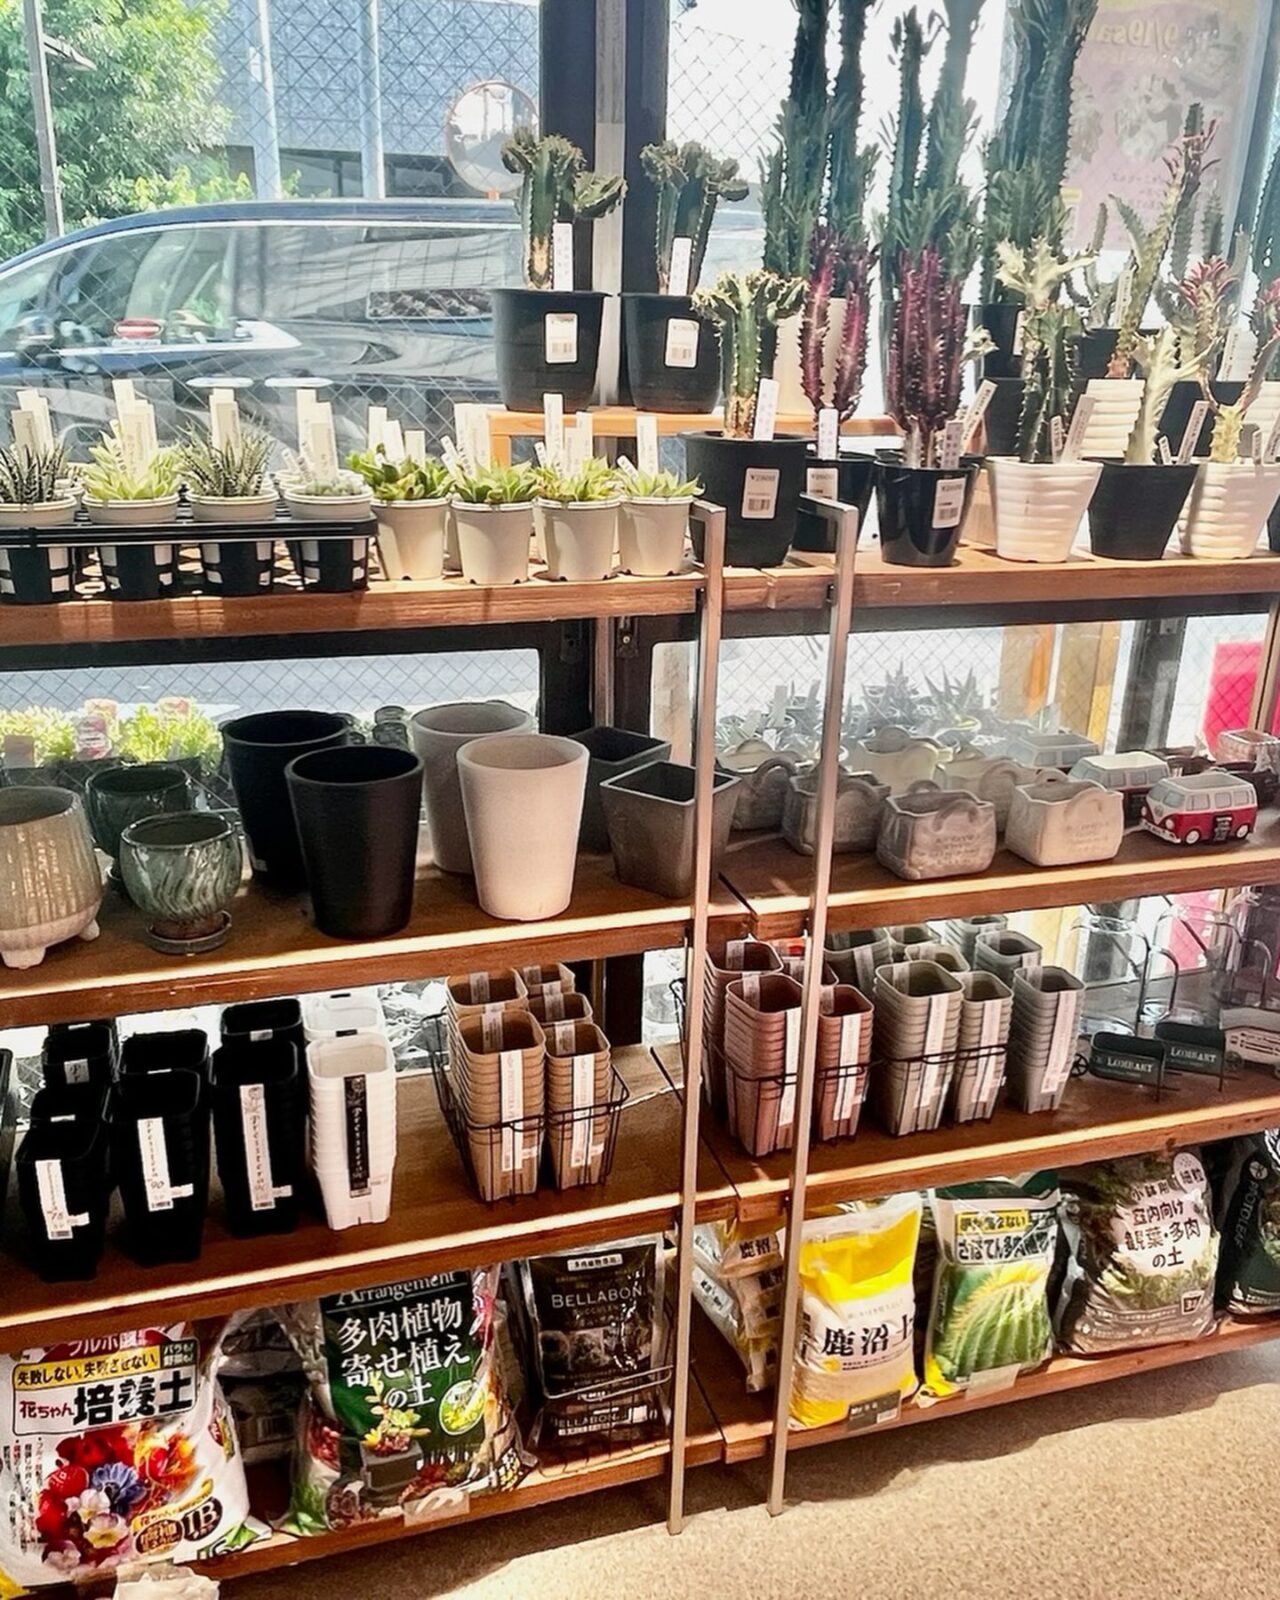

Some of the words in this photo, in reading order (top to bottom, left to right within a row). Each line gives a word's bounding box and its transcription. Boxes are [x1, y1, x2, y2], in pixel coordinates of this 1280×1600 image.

[1152, 1245, 1184, 1268] の土
[336, 1271, 456, 1306] Arrangement
[551, 1284, 643, 1309] BELLABON
[337, 1296, 463, 1354] 多肉植物
[341, 1333, 471, 1388] 寄せ植え
[73, 1371, 193, 1426] 培養土
[383, 1376, 436, 1408] の土
[19, 1399, 75, 1419] 花ちゃん
